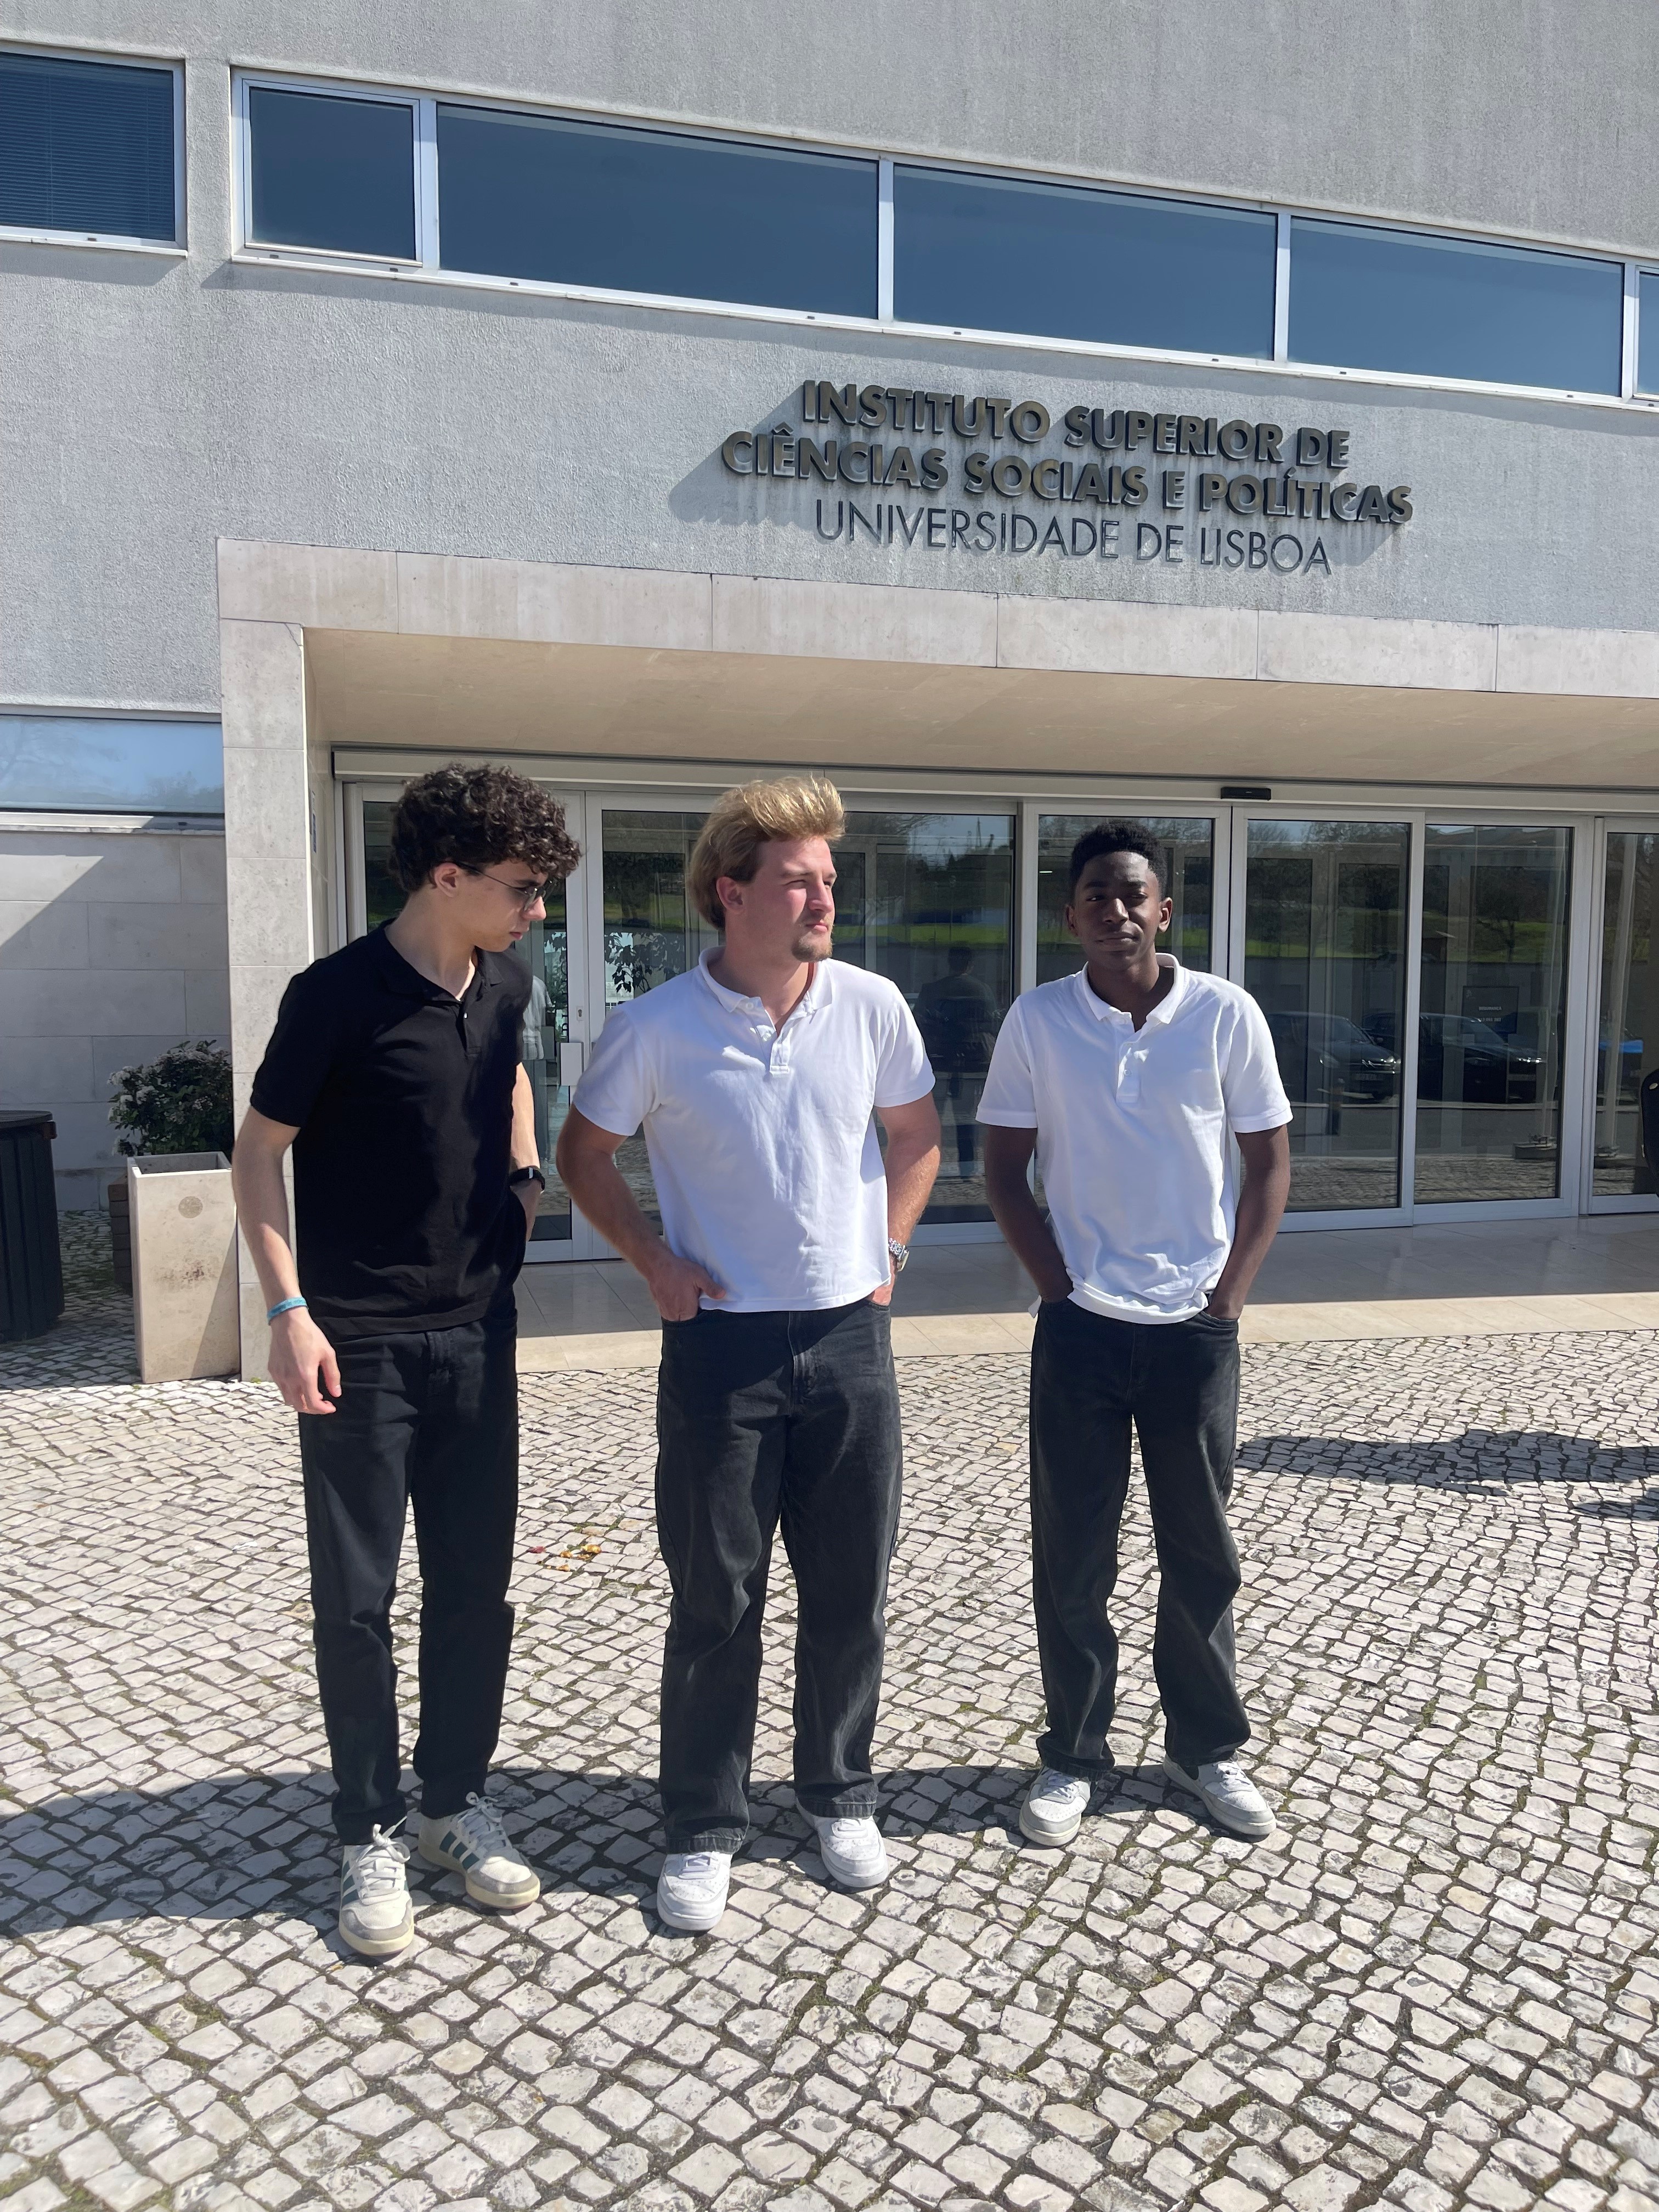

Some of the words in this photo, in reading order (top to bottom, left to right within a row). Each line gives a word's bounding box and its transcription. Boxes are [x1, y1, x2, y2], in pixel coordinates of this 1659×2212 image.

[803, 380, 1050, 444] INSTITUTO
[1064, 405, 1284, 464] SUPERIOR
[1296, 427, 1350, 469] DE
[722, 422, 949, 492] CIÊNCIAS
[964, 452, 1148, 506] SOCIAIS
[1163, 470, 1185, 510] E
[1199, 467, 1413, 525] POLÍTICAS
[816, 499, 1119, 558] UNIVERSIDADE
[1137, 522, 1184, 563] DE
[1200, 527, 1332, 575] LISBOA
